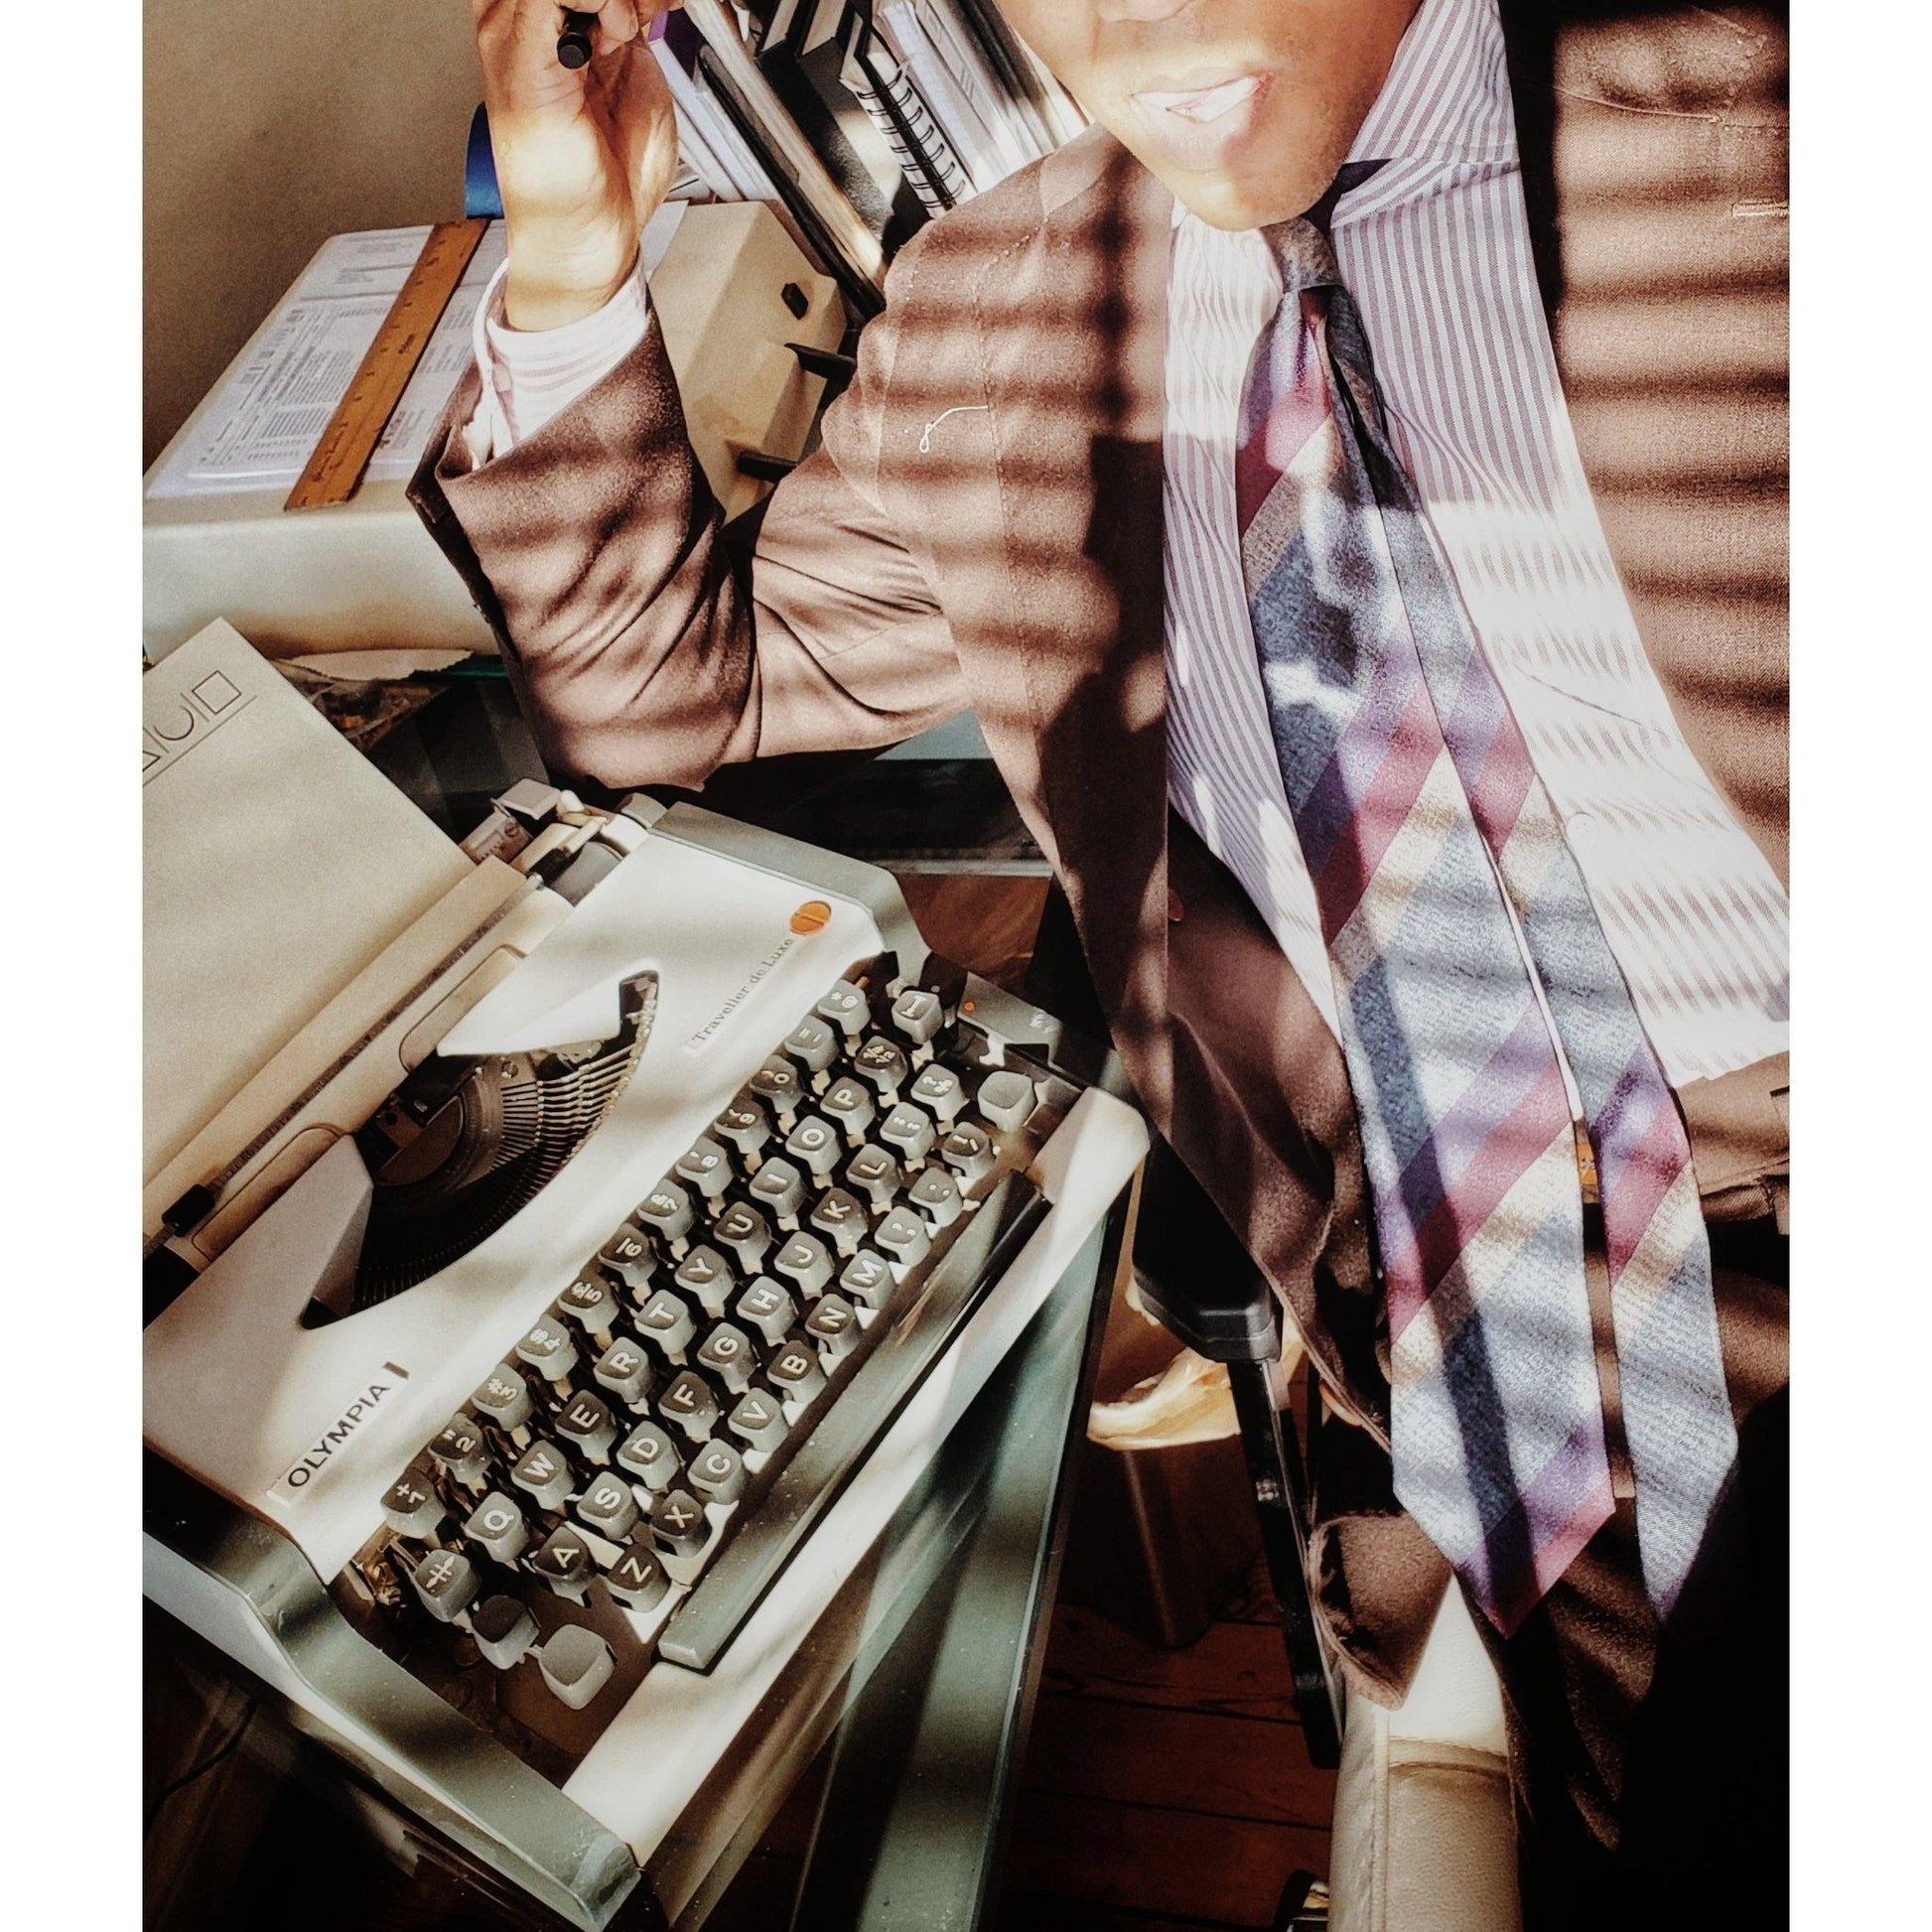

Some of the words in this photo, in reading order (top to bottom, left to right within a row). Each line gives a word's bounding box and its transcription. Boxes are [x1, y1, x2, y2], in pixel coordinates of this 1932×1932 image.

[691, 985, 750, 1041] Traveller
[834, 1089, 854, 1106] P
[739, 1113, 756, 1125] 9
[802, 1128, 825, 1145] O
[701, 1155, 719, 1168] 8
[860, 1162, 887, 1174] L
[766, 1173, 787, 1184] I
[823, 1200, 851, 1219] K
[726, 1213, 753, 1232] U
[624, 1243, 642, 1256] 6
[794, 1244, 813, 1264] J
[687, 1258, 713, 1274] Y
[851, 1259, 883, 1285] M
[585, 1290, 603, 1303] 5
[751, 1289, 779, 1310] H
[648, 1302, 674, 1319] T
[818, 1307, 847, 1327] N
[546, 1338, 561, 1350] 4
[714, 1336, 739, 1356] G
[610, 1351, 638, 1372] R
[780, 1354, 808, 1375] B
[499, 1386, 517, 1401] 3
[673, 1383, 694, 1407] F
[570, 1404, 600, 1429] E
[742, 1401, 768, 1419] V
[288, 1384, 391, 1487] OLYMPIA
[456, 1437, 476, 1452] 2
[630, 1438, 659, 1458] D
[523, 1451, 555, 1478] W
[706, 1453, 731, 1474] C
[595, 1488, 621, 1509] S
[483, 1509, 514, 1531] Q
[664, 1505, 694, 1529] X
[552, 1548, 580, 1569] A
[620, 1557, 652, 1583] Z
